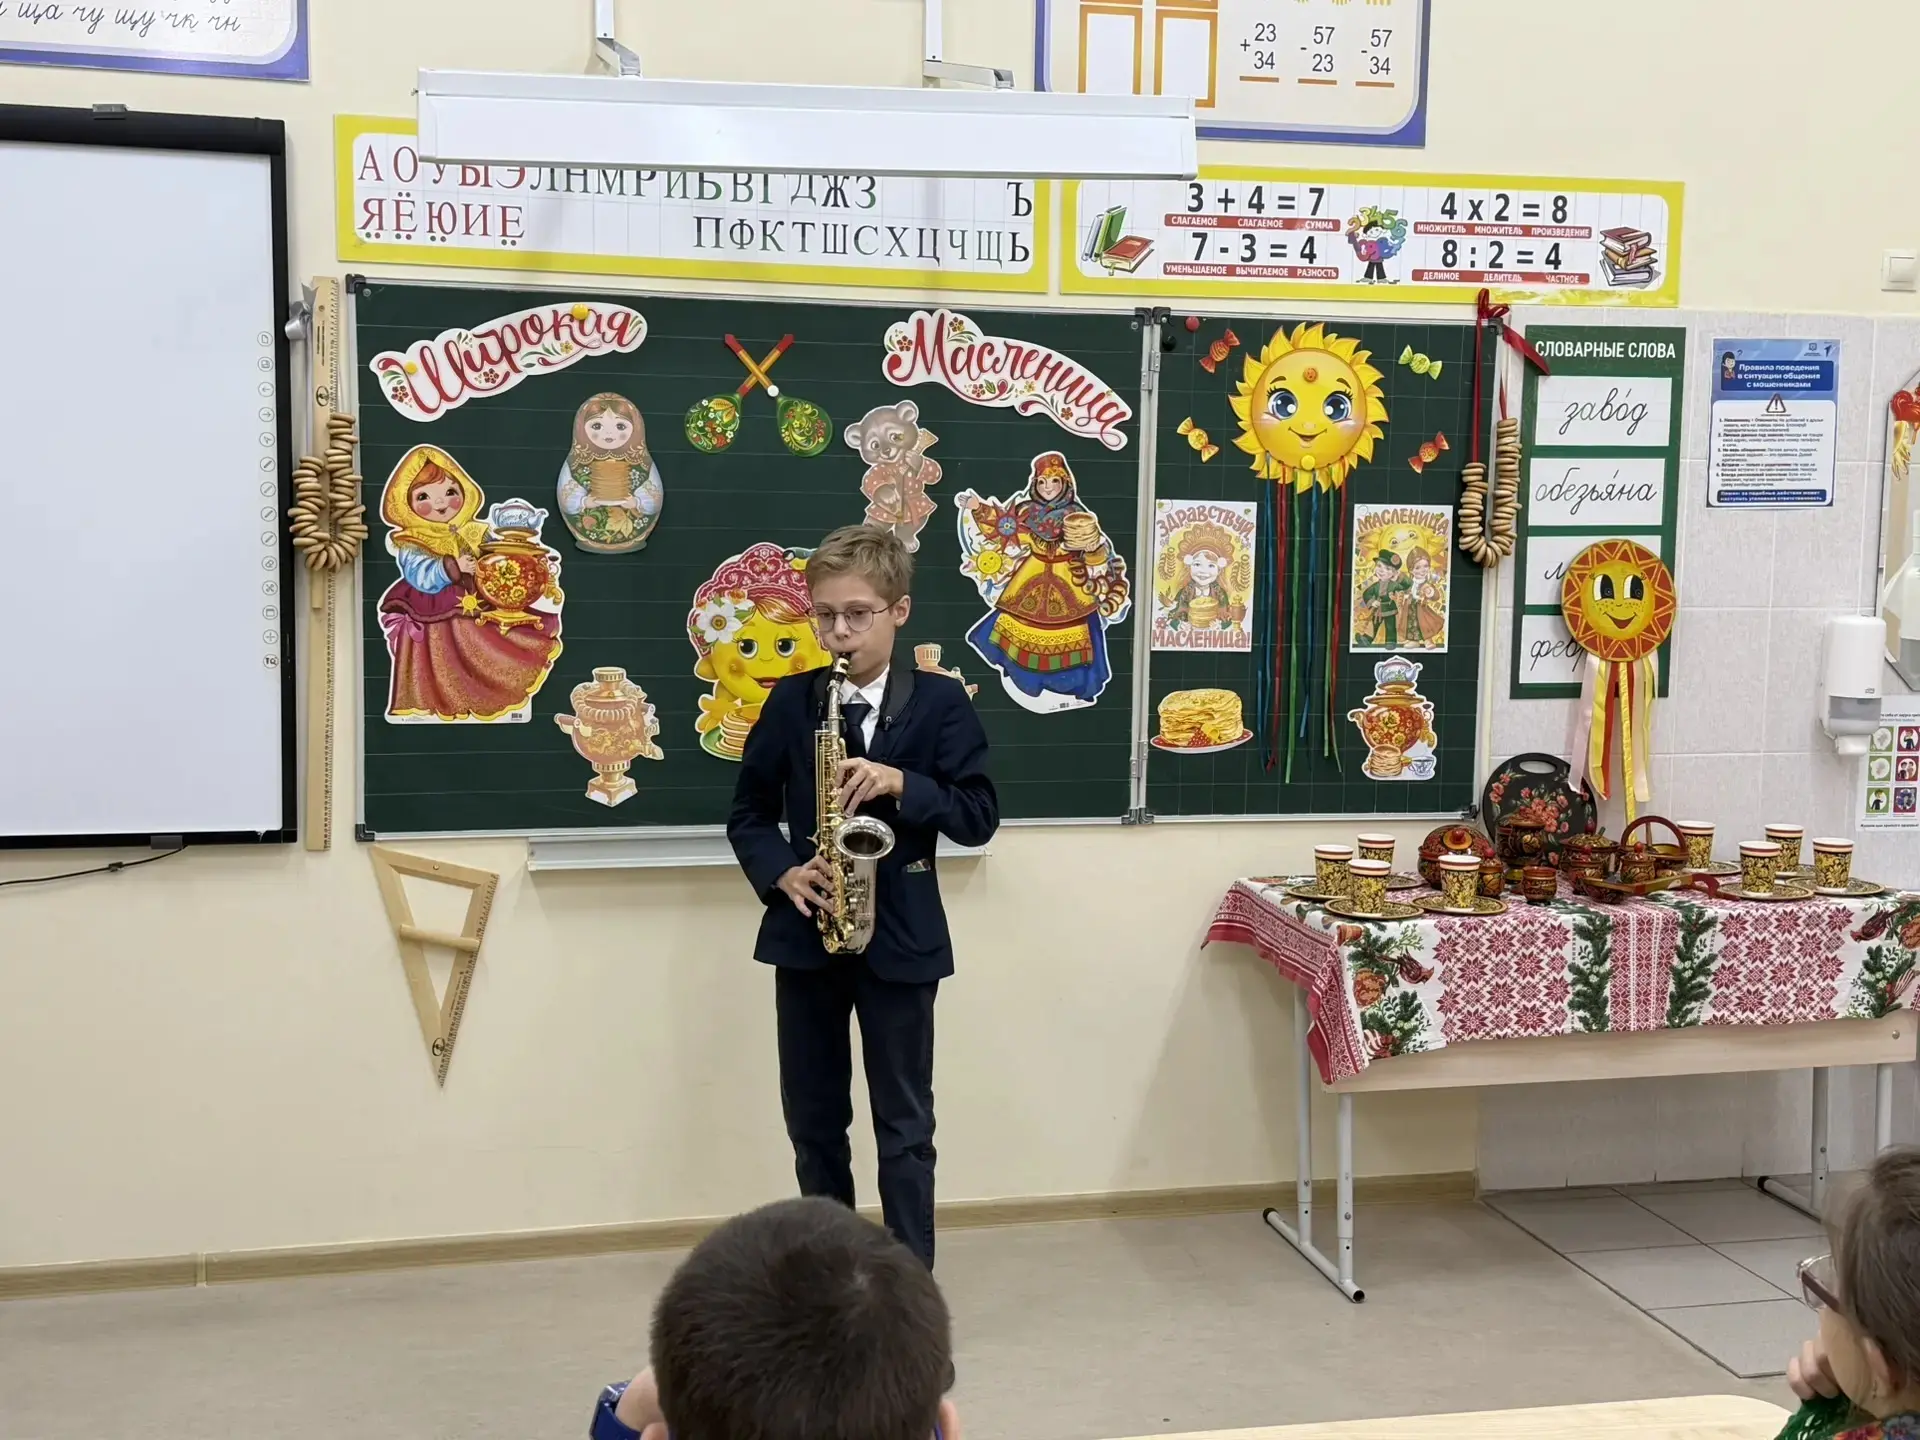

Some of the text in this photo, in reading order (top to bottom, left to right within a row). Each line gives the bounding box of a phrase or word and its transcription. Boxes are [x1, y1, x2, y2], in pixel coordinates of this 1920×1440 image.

[1254, 22, 1277, 42] 23
[1313, 26, 1335, 45] 57
[1370, 29, 1392, 48] 57
[1254, 50, 1275, 70] 34
[1312, 53, 1334, 72] 23
[1369, 56, 1391, 75] 34
[1187, 183, 1204, 213] 3
[1248, 185, 1265, 214] 4
[1309, 187, 1325, 216] 7
[1441, 191, 1457, 220] 4
[1495, 193, 1510, 222] 2
[1552, 195, 1568, 224] 8
[1171, 215, 1334, 230] СЛАГАЕМОЕ СЛАГАЕМОЕ СУММА
[1417, 224, 1590, 238] МНОЖИТЕЛЬ МНОЖИТЕЛЬ ПРОИЗВЕДЕНИЕ
[1192, 232, 1208, 261] 7
[1240, 233, 1257, 263] 3
[1300, 235, 1317, 265] 4
[1441, 239, 1458, 268] 8
[1488, 240, 1504, 269] 2
[1545, 242, 1562, 270] 4
[1165, 263, 1337, 278] УМЕНЬШАЕМОЕ ВЫЧИТАЕМОЕ РАЗНОСТЬ
[1422, 271, 1580, 284] ДЕЛИМОЕ ДЕЛИТЕЛЬ ЧАСТНОЕ
[1535, 341, 1676, 358] СЛОВАРНЫЕ СЛОВА
[377, 308, 642, 415] Широкая
[1739, 363, 1820, 373] Правила поведения
[887, 312, 1128, 447] Масленица
[1744, 373, 1782, 381] ситуации
[1783, 372, 1821, 380] общения
